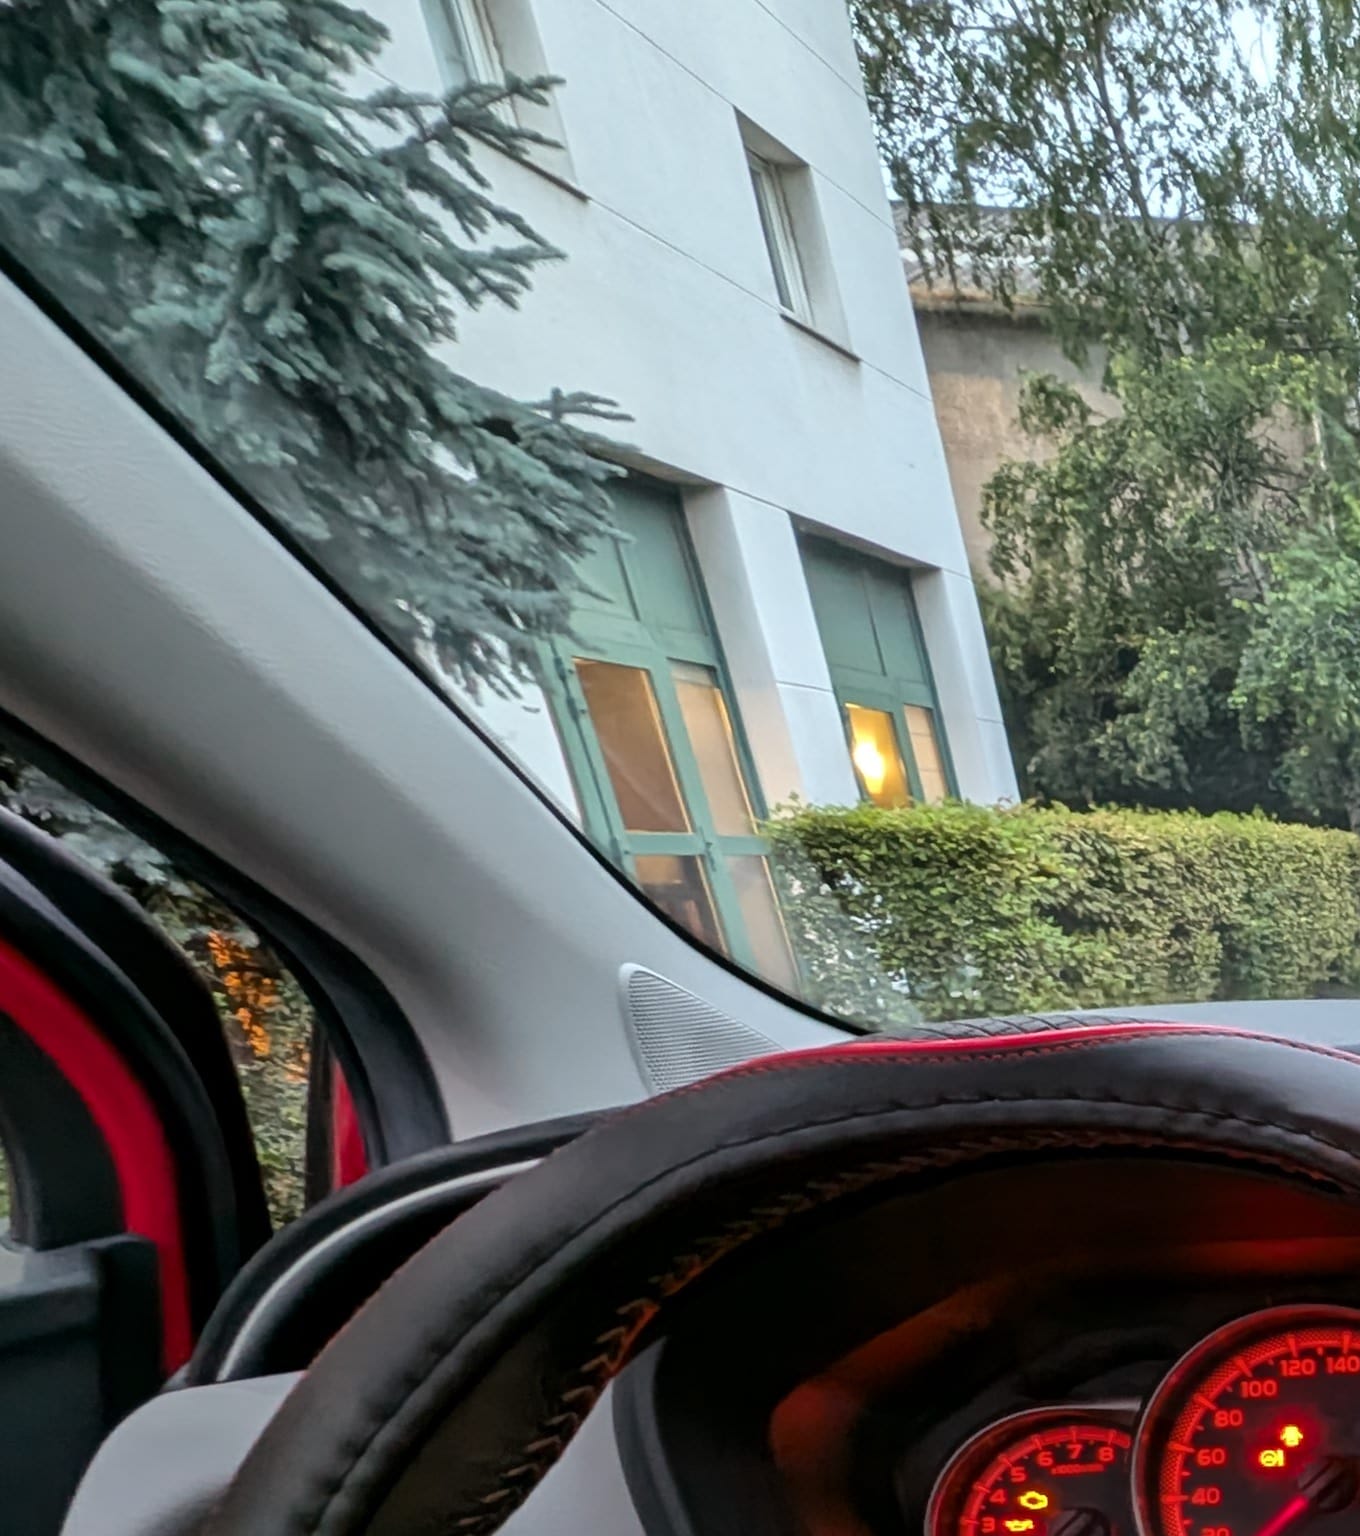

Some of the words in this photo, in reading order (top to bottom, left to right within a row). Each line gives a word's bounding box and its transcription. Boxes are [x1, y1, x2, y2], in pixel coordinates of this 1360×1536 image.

[1281, 1359, 1315, 1376] 120
[1326, 1356, 1360, 1373] 140
[1241, 1379, 1277, 1397] 100
[1214, 1410, 1243, 1427] 80
[1037, 1451, 1053, 1466] 6
[1067, 1444, 1082, 1459] 7
[1098, 1447, 1114, 1462] 8
[1197, 1448, 1225, 1466] 60
[1010, 1467, 1026, 1482] 5
[990, 1488, 1006, 1504] 4
[1191, 1487, 1220, 1504] 40
[981, 1516, 995, 1532] 3
